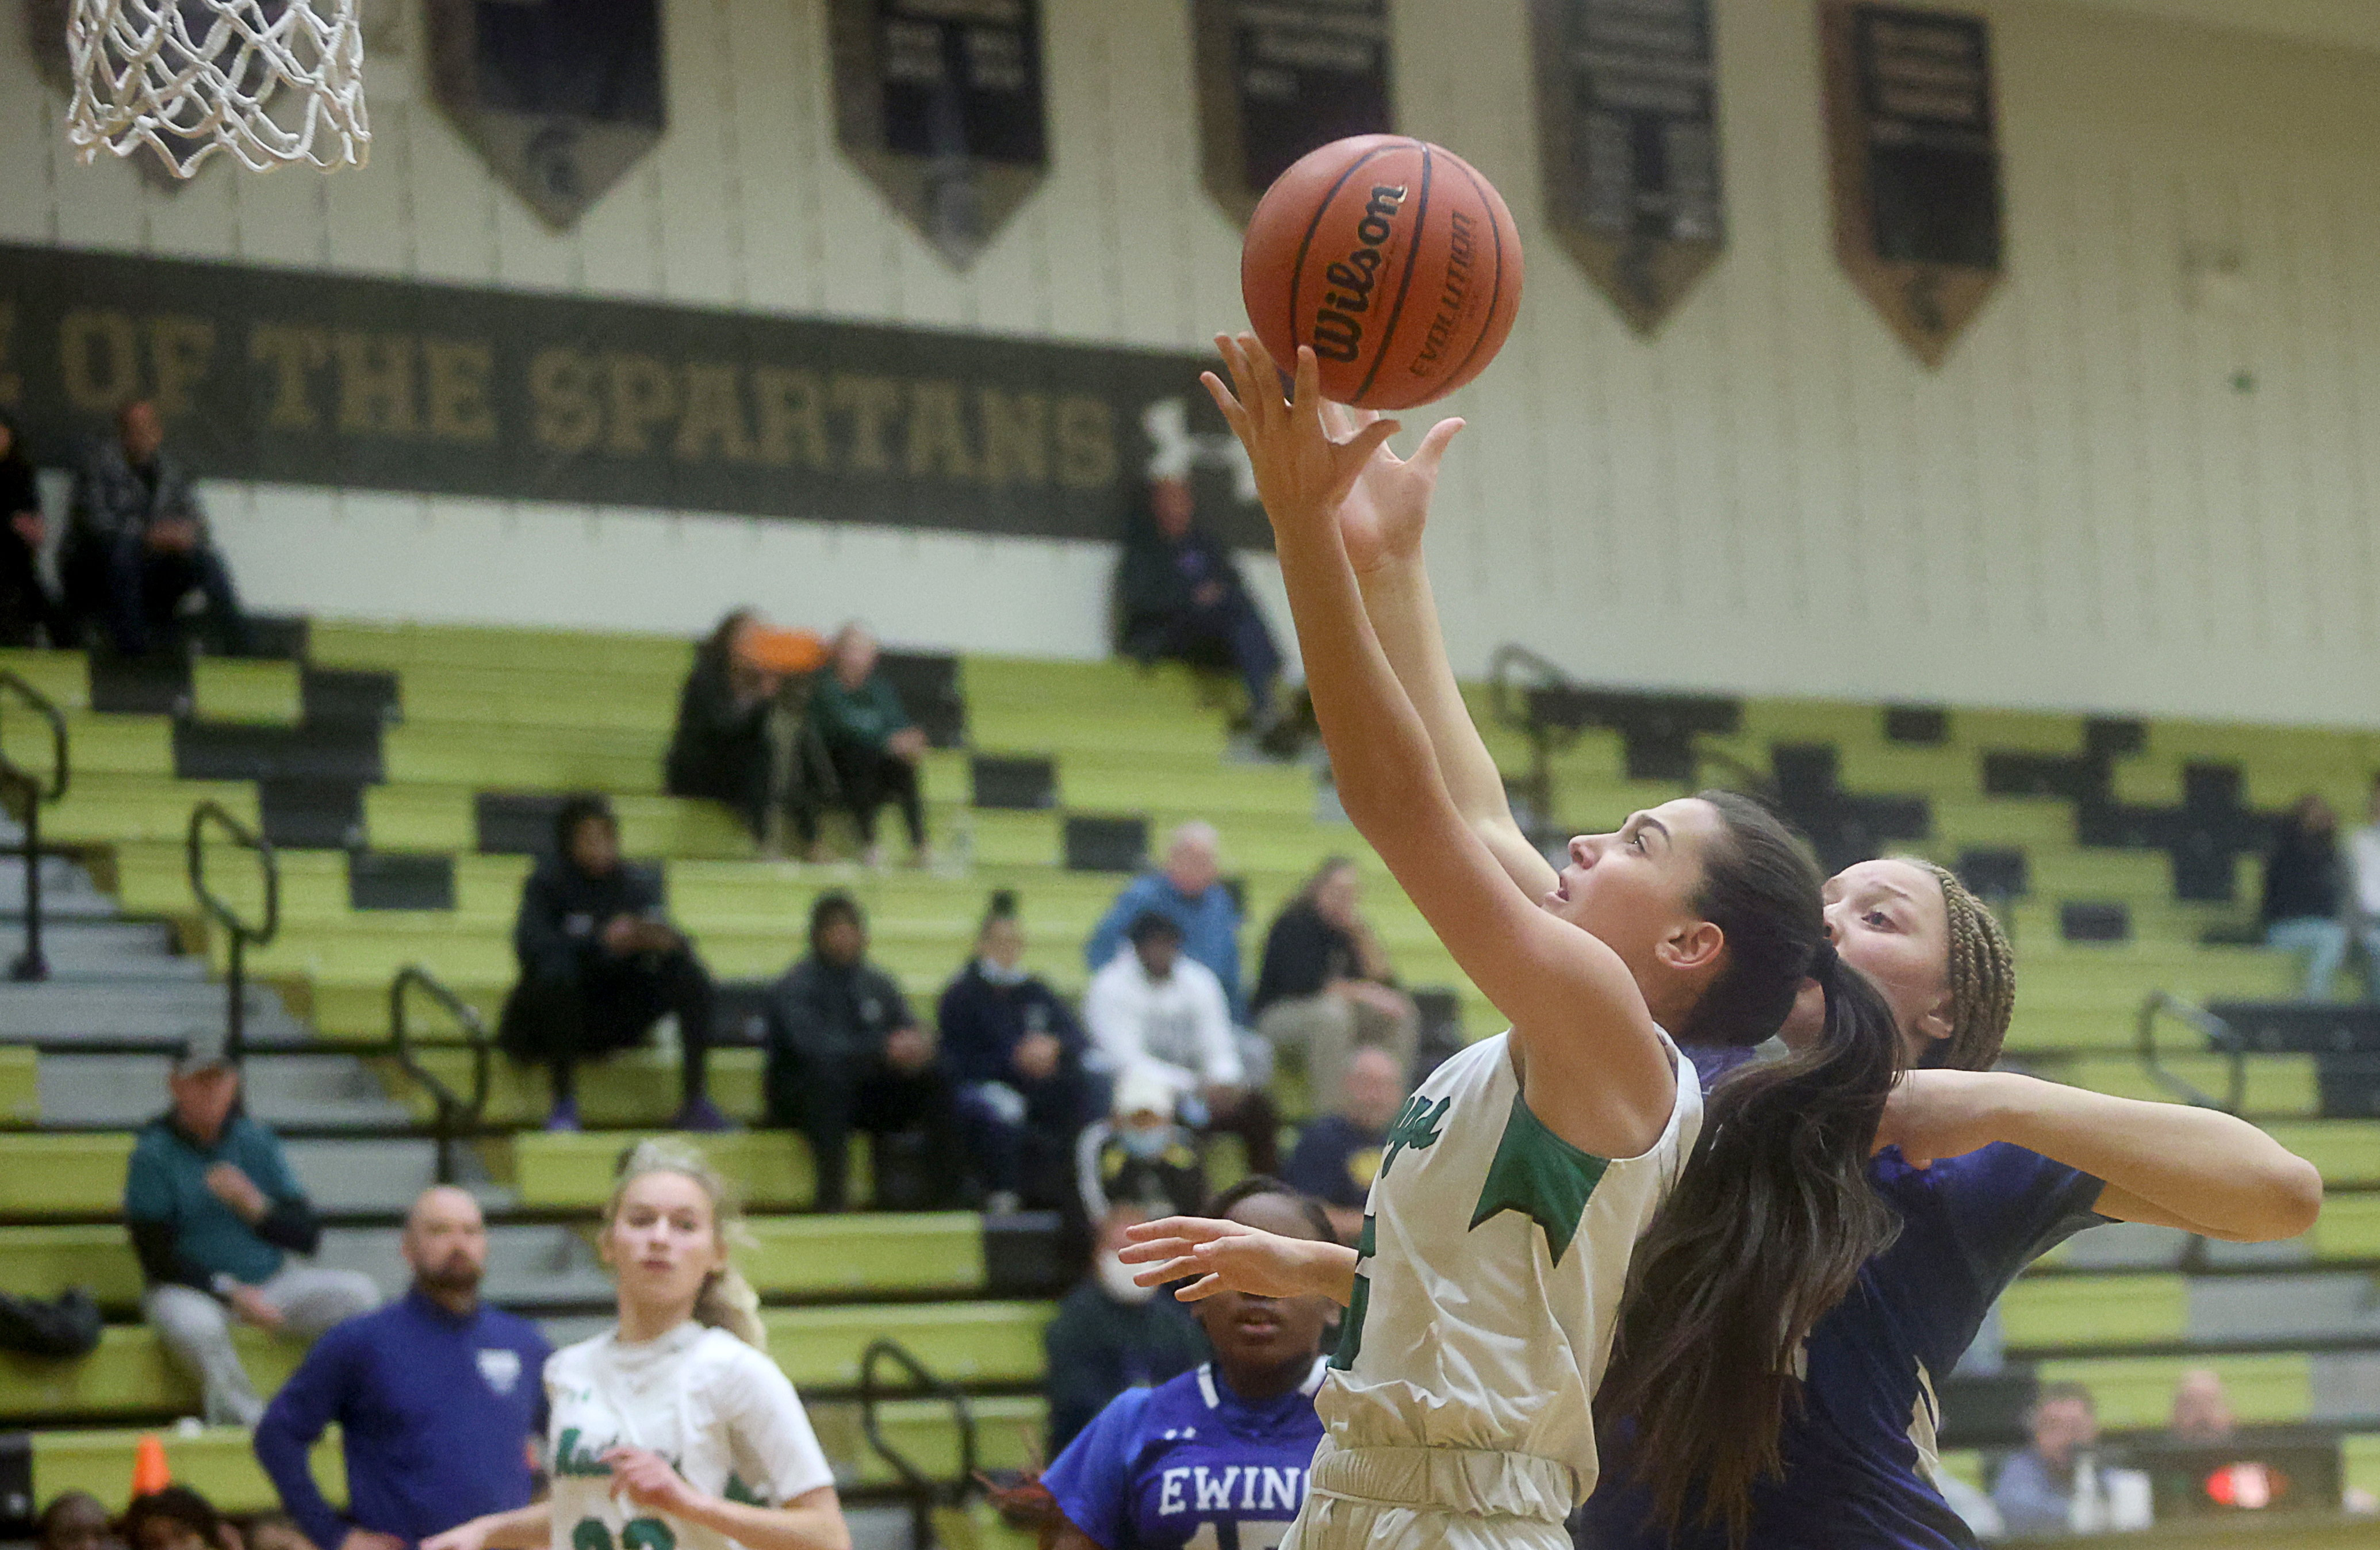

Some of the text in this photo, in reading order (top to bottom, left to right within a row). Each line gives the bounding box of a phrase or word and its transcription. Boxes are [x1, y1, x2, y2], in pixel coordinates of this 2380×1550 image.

[1312, 185, 1408, 363] Wilson
[1408, 209, 1472, 377] EVOLUTION
[58, 309, 216, 418] OF
[248, 322, 499, 444] THE
[528, 345, 1120, 490] SPARTANS
